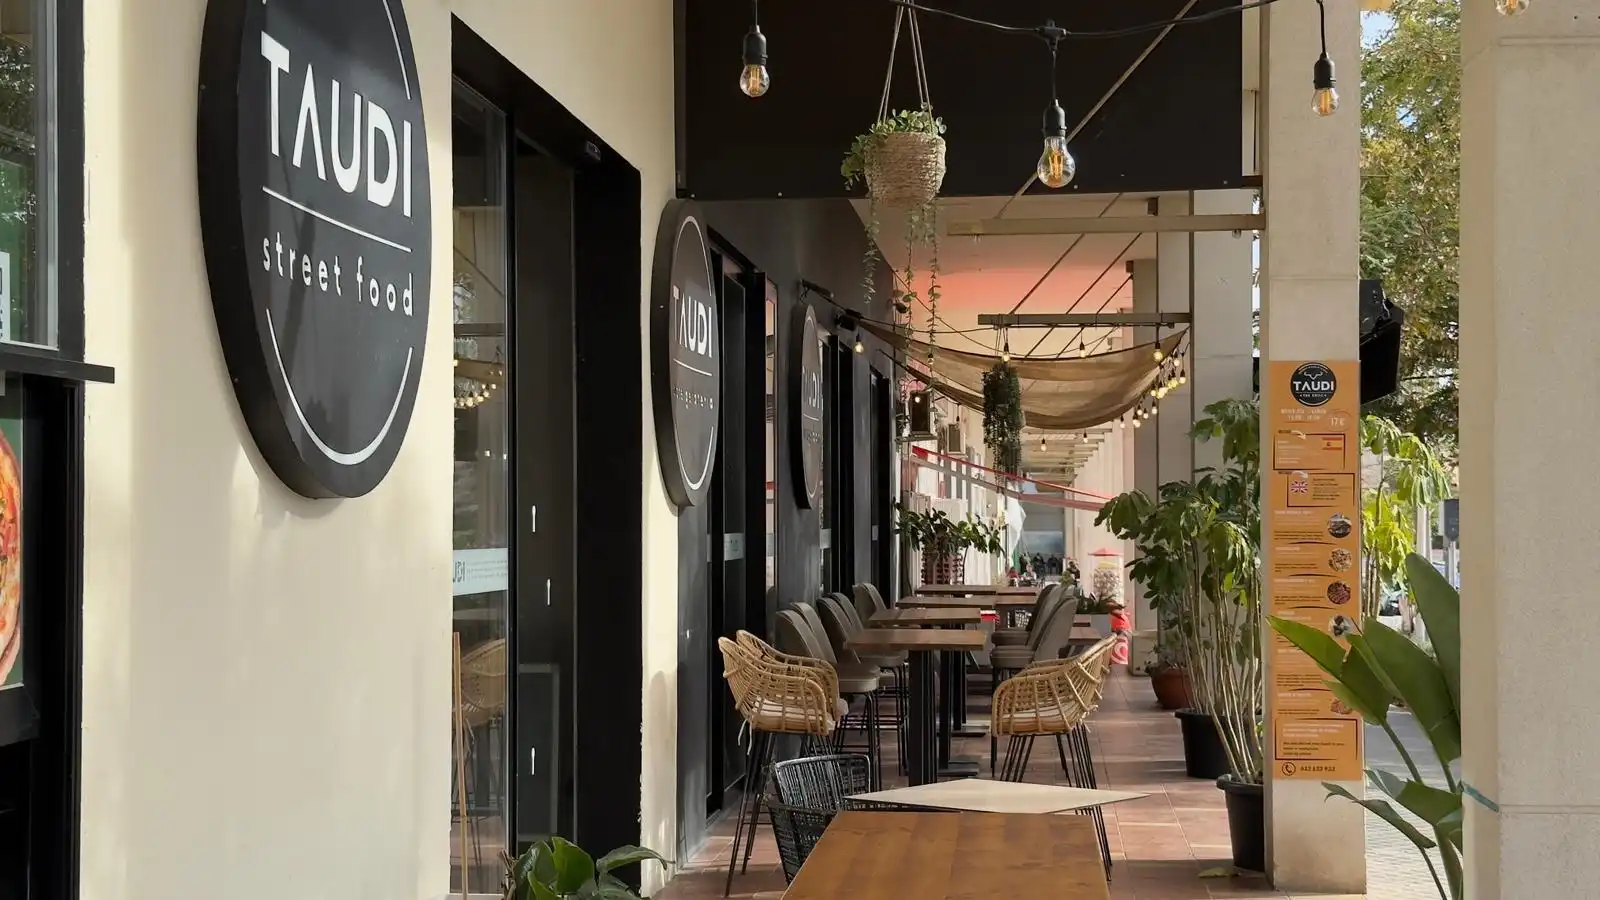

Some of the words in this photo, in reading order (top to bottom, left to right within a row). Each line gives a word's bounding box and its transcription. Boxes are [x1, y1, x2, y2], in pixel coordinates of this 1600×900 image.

[260, 31, 413, 218] TAUDI
[262, 231, 343, 297] street
[356, 256, 414, 317] food
[672, 285, 713, 358] TAUDI
[1292, 380, 1335, 391] TAUDI
